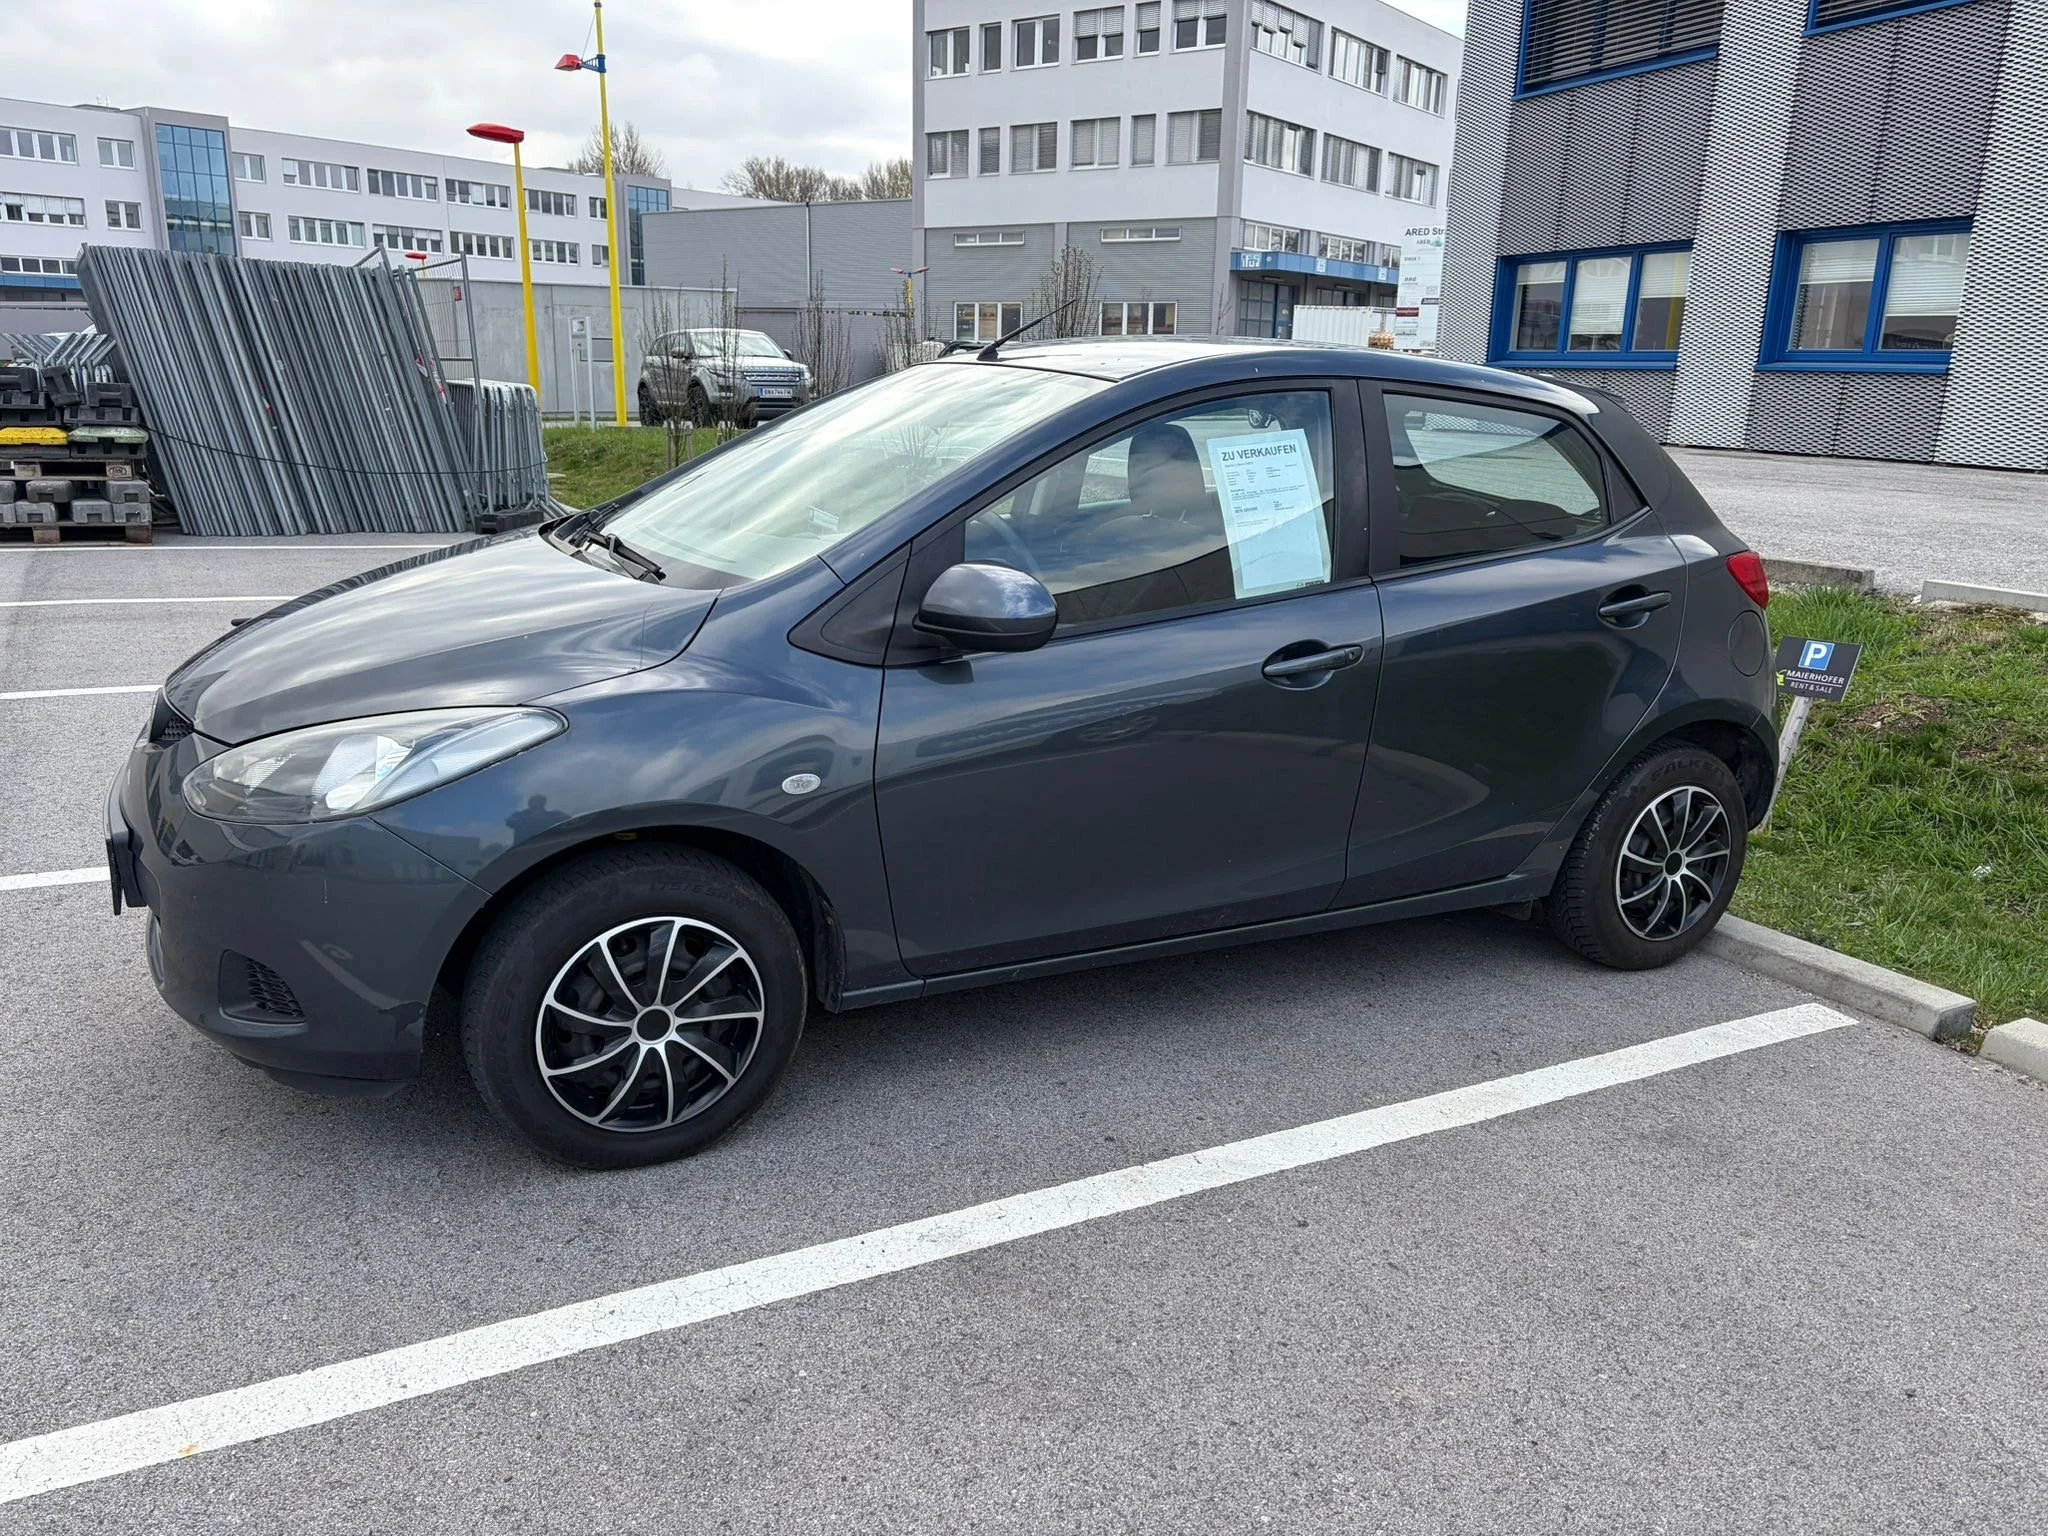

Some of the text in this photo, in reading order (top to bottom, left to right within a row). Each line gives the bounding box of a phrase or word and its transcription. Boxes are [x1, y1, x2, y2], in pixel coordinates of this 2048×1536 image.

[1405, 228, 1430, 236] ARED
[1221, 444, 1297, 462] ZU VERKAUFEN
[1803, 643, 1828, 666] P
[1786, 670, 1845, 685] MAIERHOFER
